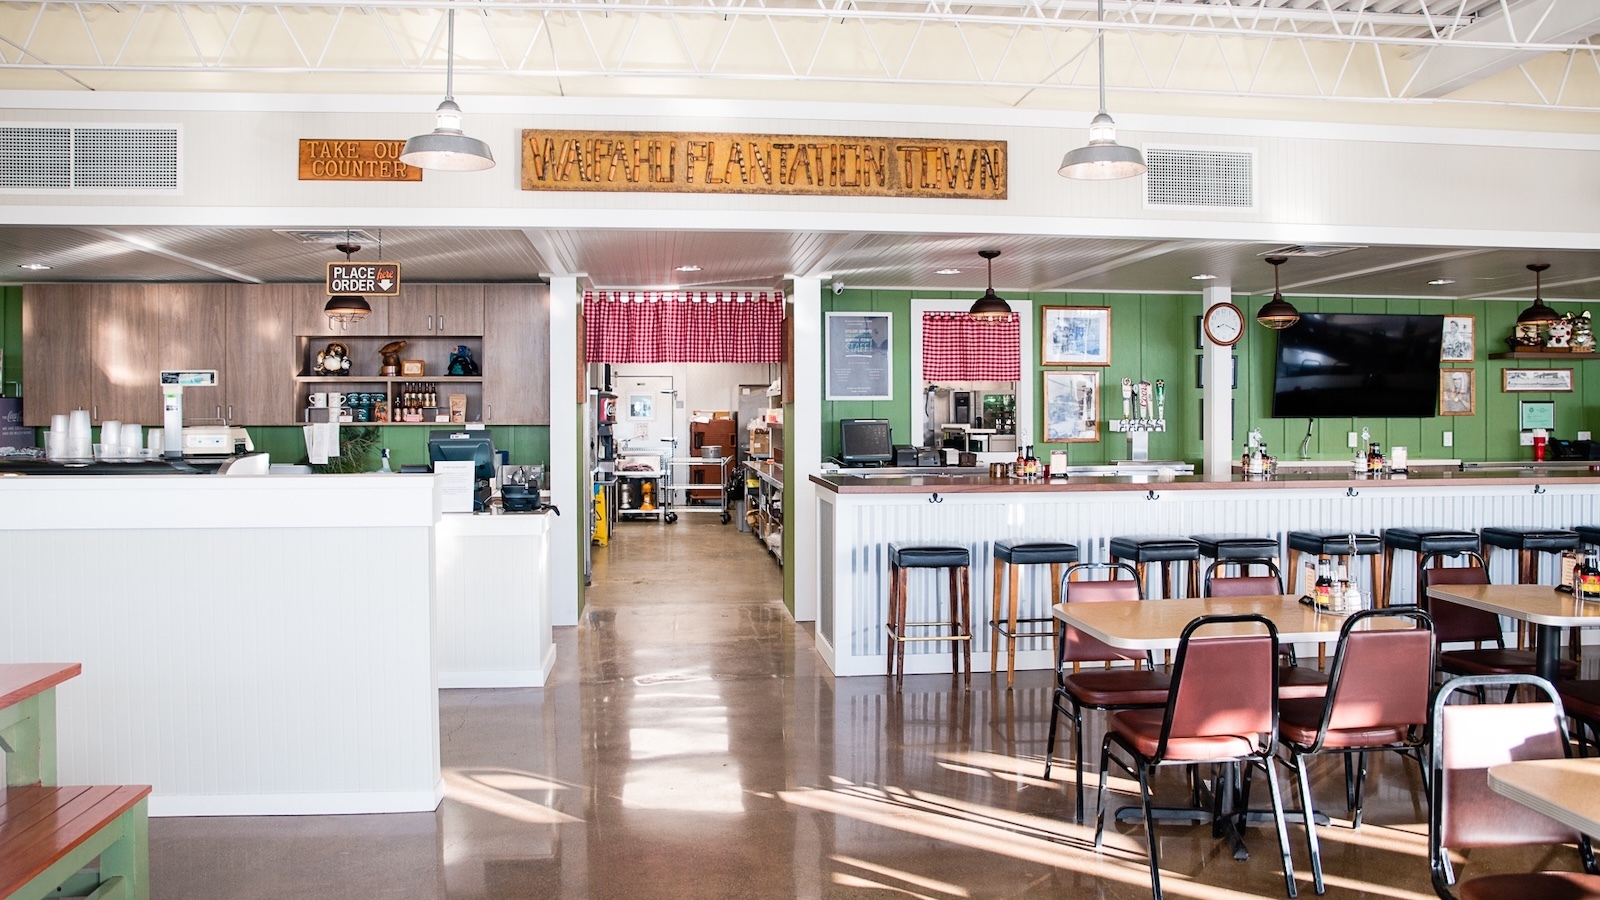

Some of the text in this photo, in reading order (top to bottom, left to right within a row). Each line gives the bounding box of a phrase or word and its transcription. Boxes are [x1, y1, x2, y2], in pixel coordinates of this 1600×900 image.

[306, 141, 406, 159] TAKE OU
[312, 160, 408, 178] COUNTER
[529, 138, 1000, 190] WAIPAHU PLANTATION TOWN
[333, 267, 394, 280] PLACE here
[332, 279, 375, 291] ORDER
